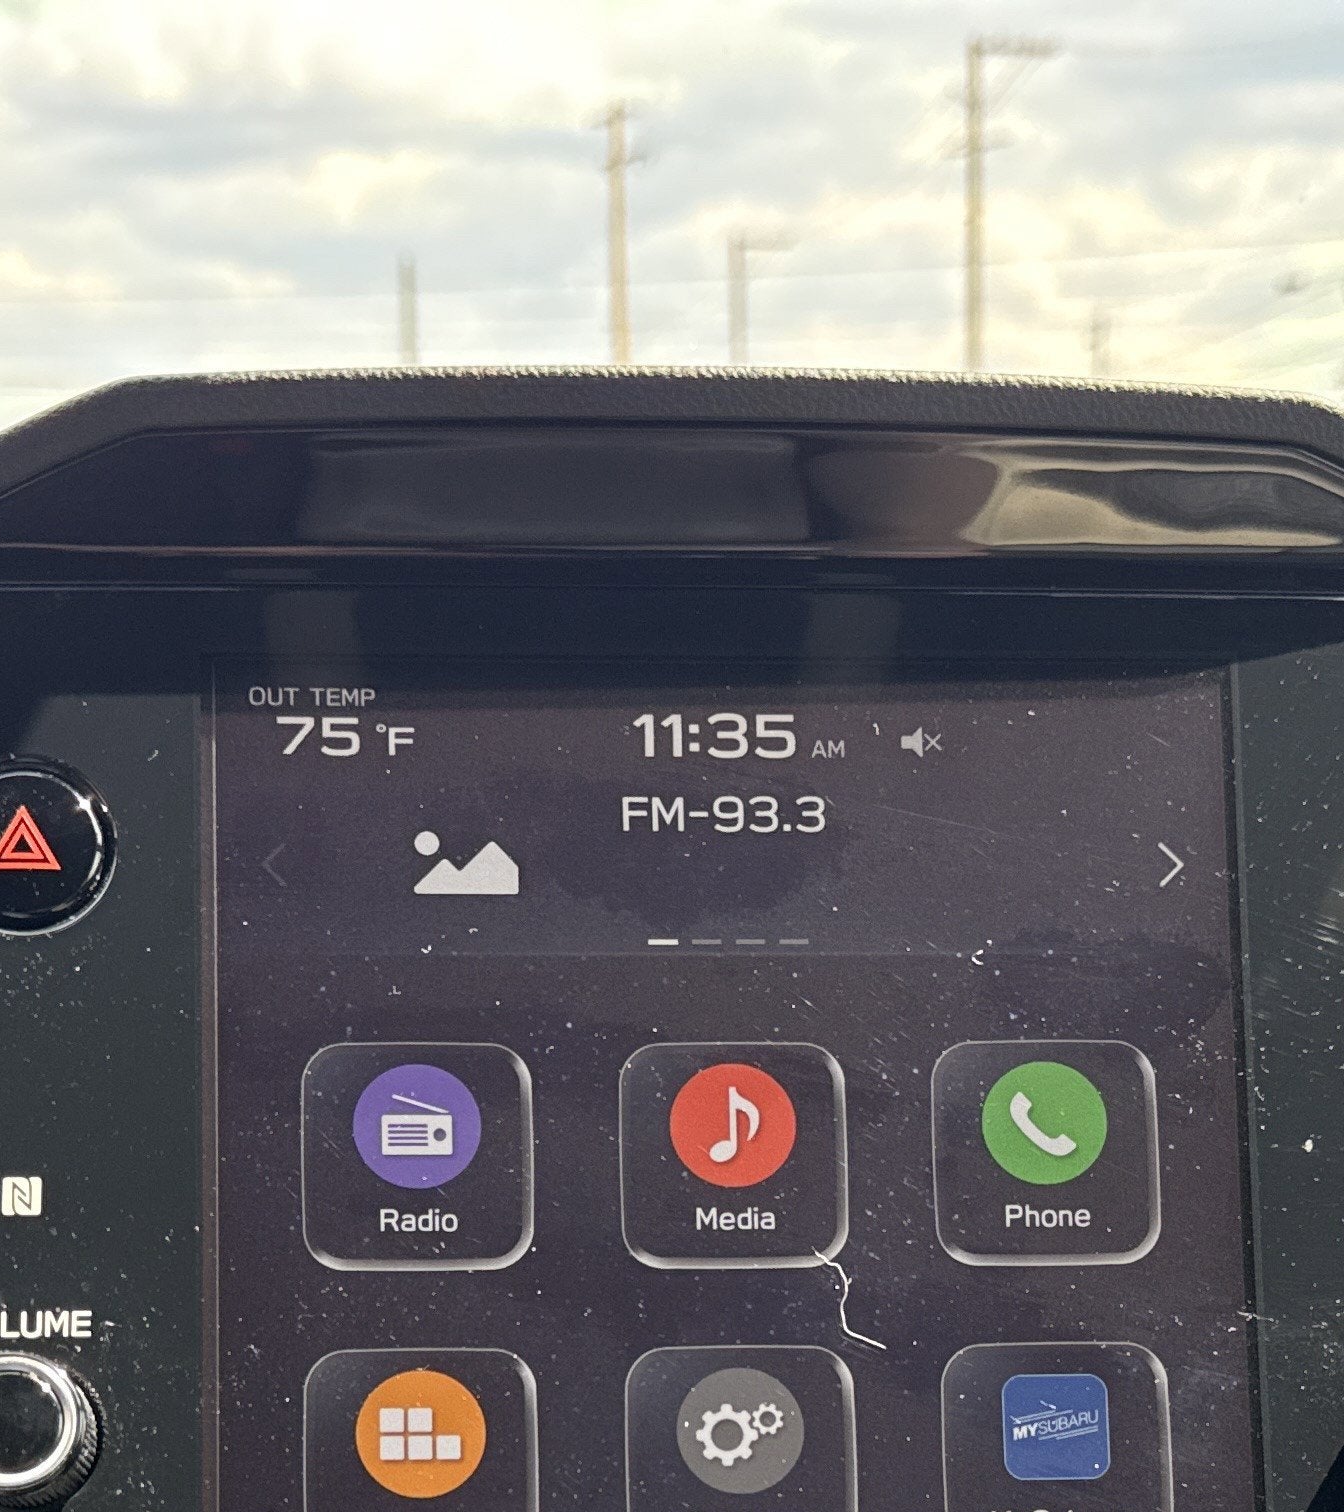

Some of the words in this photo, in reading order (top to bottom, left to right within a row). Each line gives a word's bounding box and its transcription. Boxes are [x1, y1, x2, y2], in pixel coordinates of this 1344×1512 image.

[248, 687, 298, 707] OUT
[308, 687, 377, 708] TEMP
[275, 716, 360, 757] 75
[631, 713, 798, 760] 11:35
[810, 739, 846, 759] AM
[620, 795, 827, 833] FM-93.3
[378, 1208, 459, 1236] Radio
[694, 1206, 777, 1232] Media
[1003, 1203, 1092, 1230] Phone
[1012, 1408, 1100, 1442] MYSUBARU
